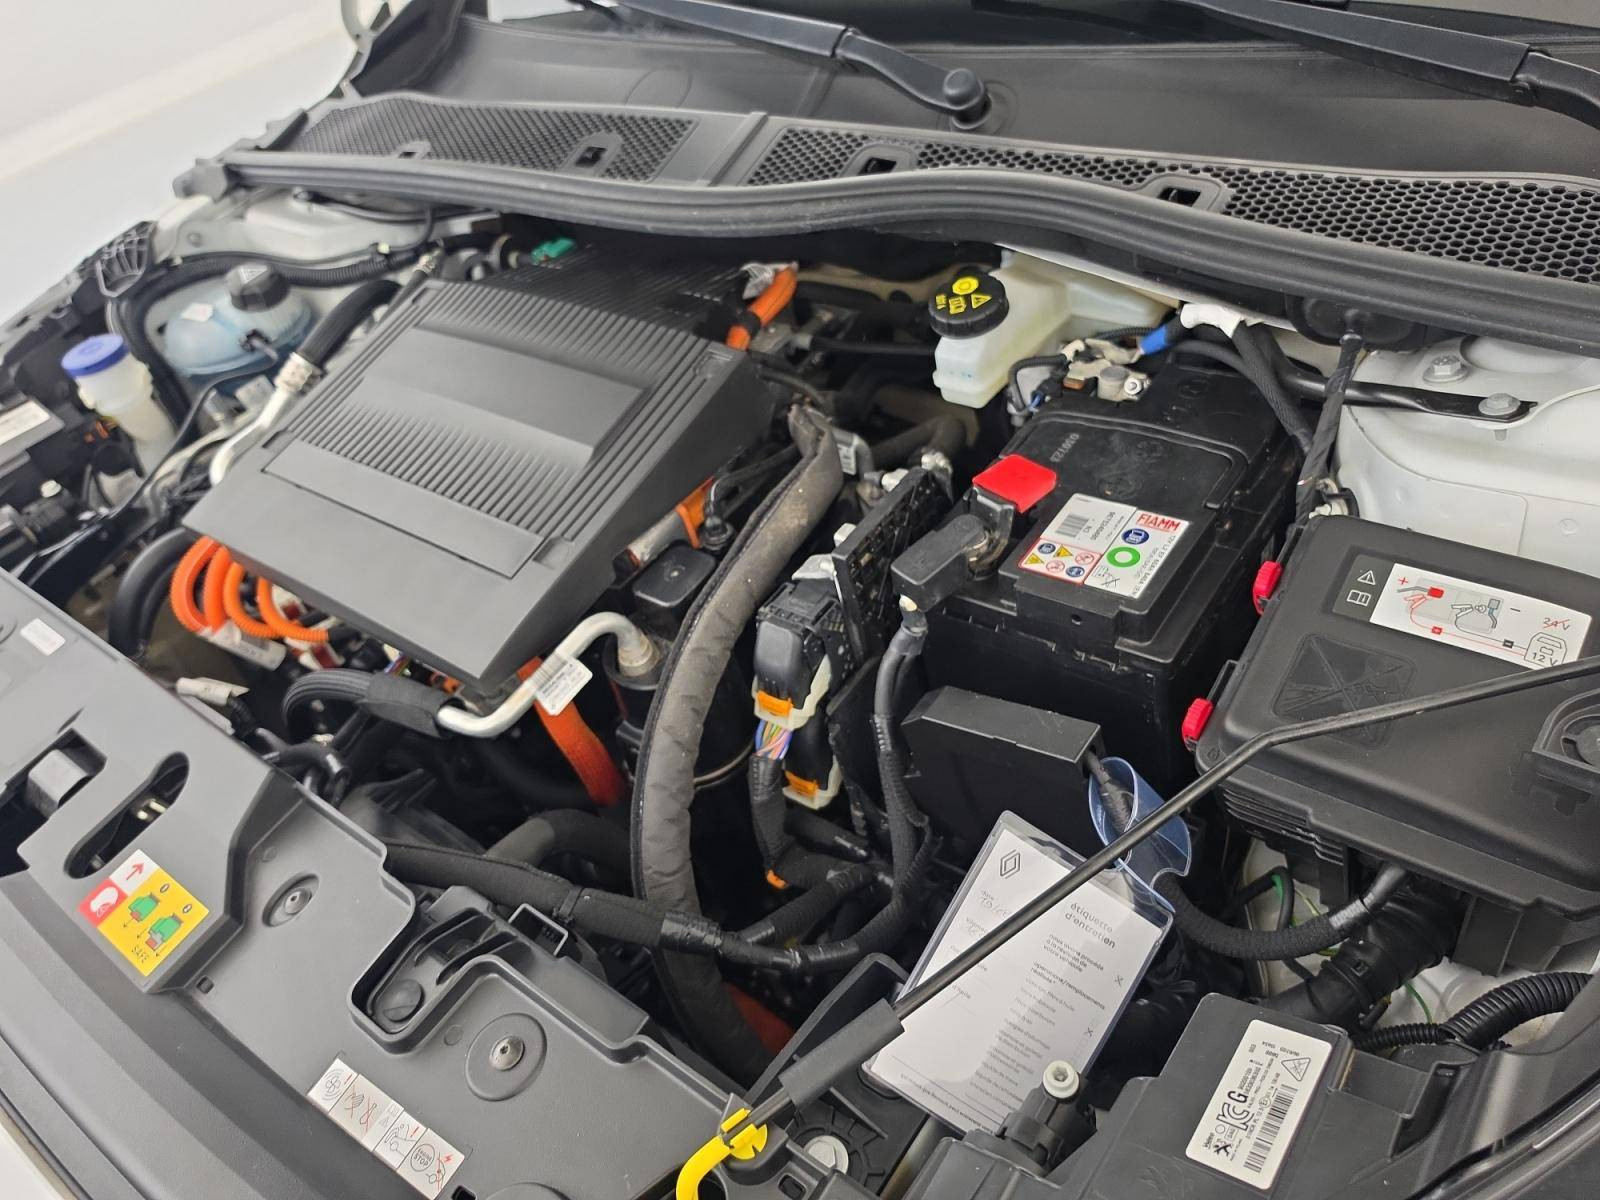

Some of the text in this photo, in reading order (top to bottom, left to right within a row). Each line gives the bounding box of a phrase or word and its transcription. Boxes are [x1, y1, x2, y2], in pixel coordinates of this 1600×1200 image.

[1138, 514, 1180, 531] FIAMM
[1070, 902, 1113, 934] étiquette
[1065, 912, 1116, 949] d'entretien
[413, 1153, 429, 1166] STOP
